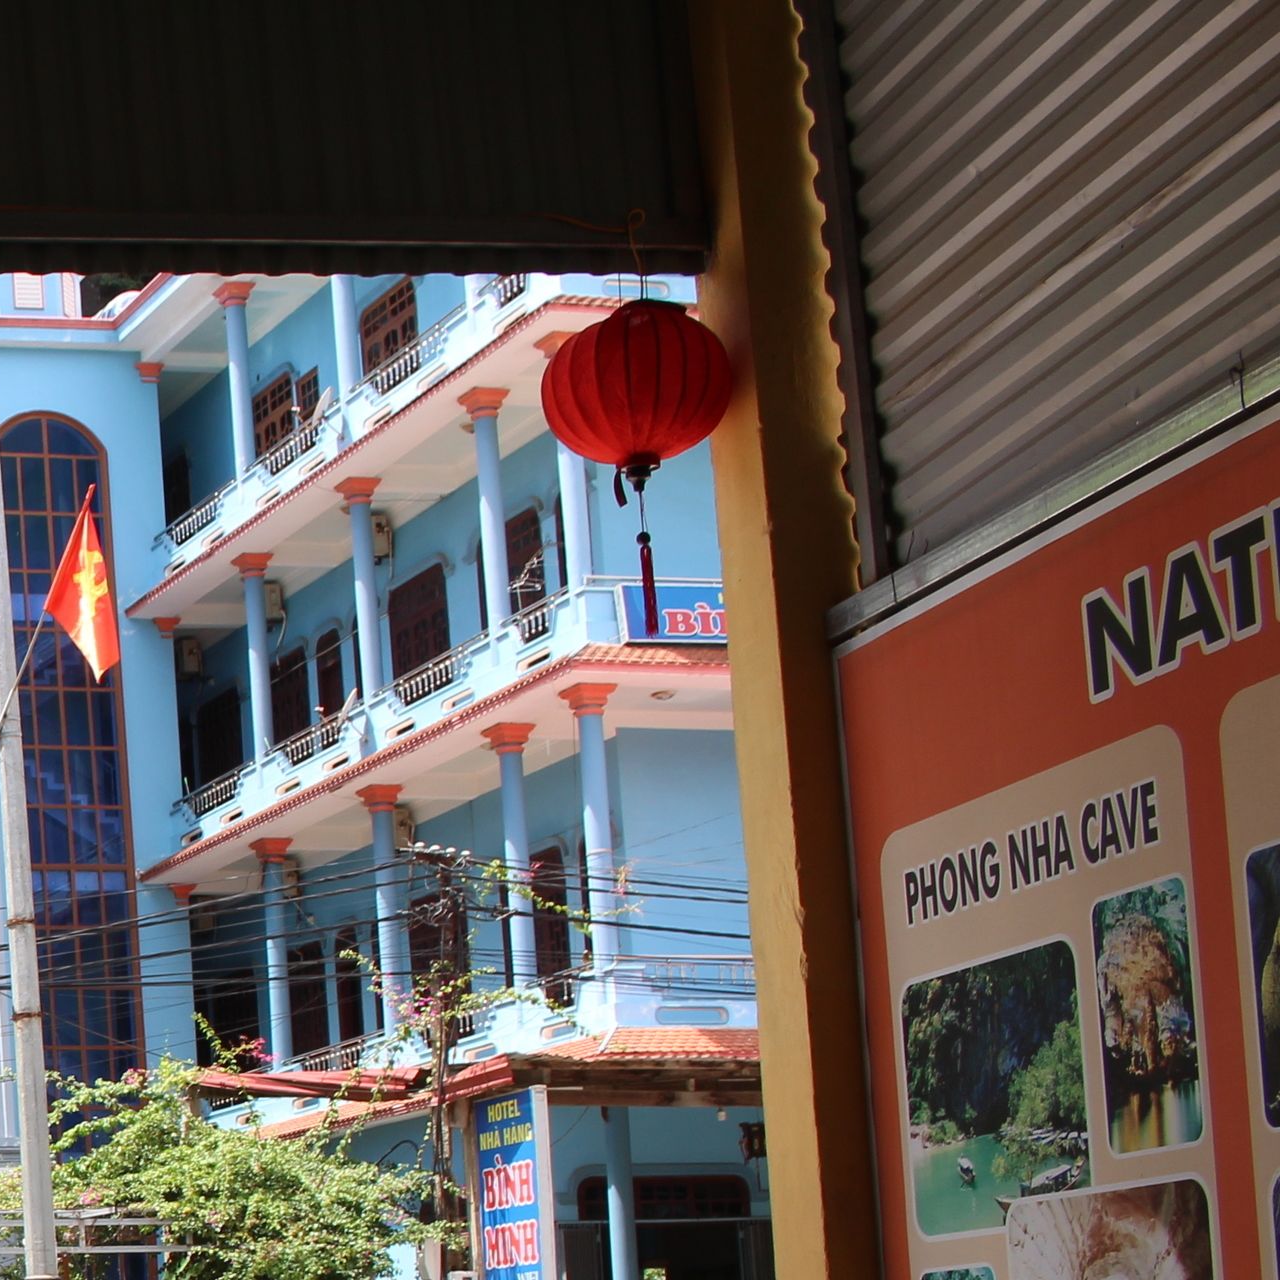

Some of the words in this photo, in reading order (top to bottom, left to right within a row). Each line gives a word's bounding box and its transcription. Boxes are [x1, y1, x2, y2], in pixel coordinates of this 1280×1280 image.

[904, 841, 1000, 926] PHONG
[1008, 814, 1075, 891] NHA
[1081, 779, 1159, 865] CAVE
[487, 1098, 521, 1123] HOTEL
[482, 1153, 535, 1211] BÌNH
[484, 1218, 539, 1270] MINH
